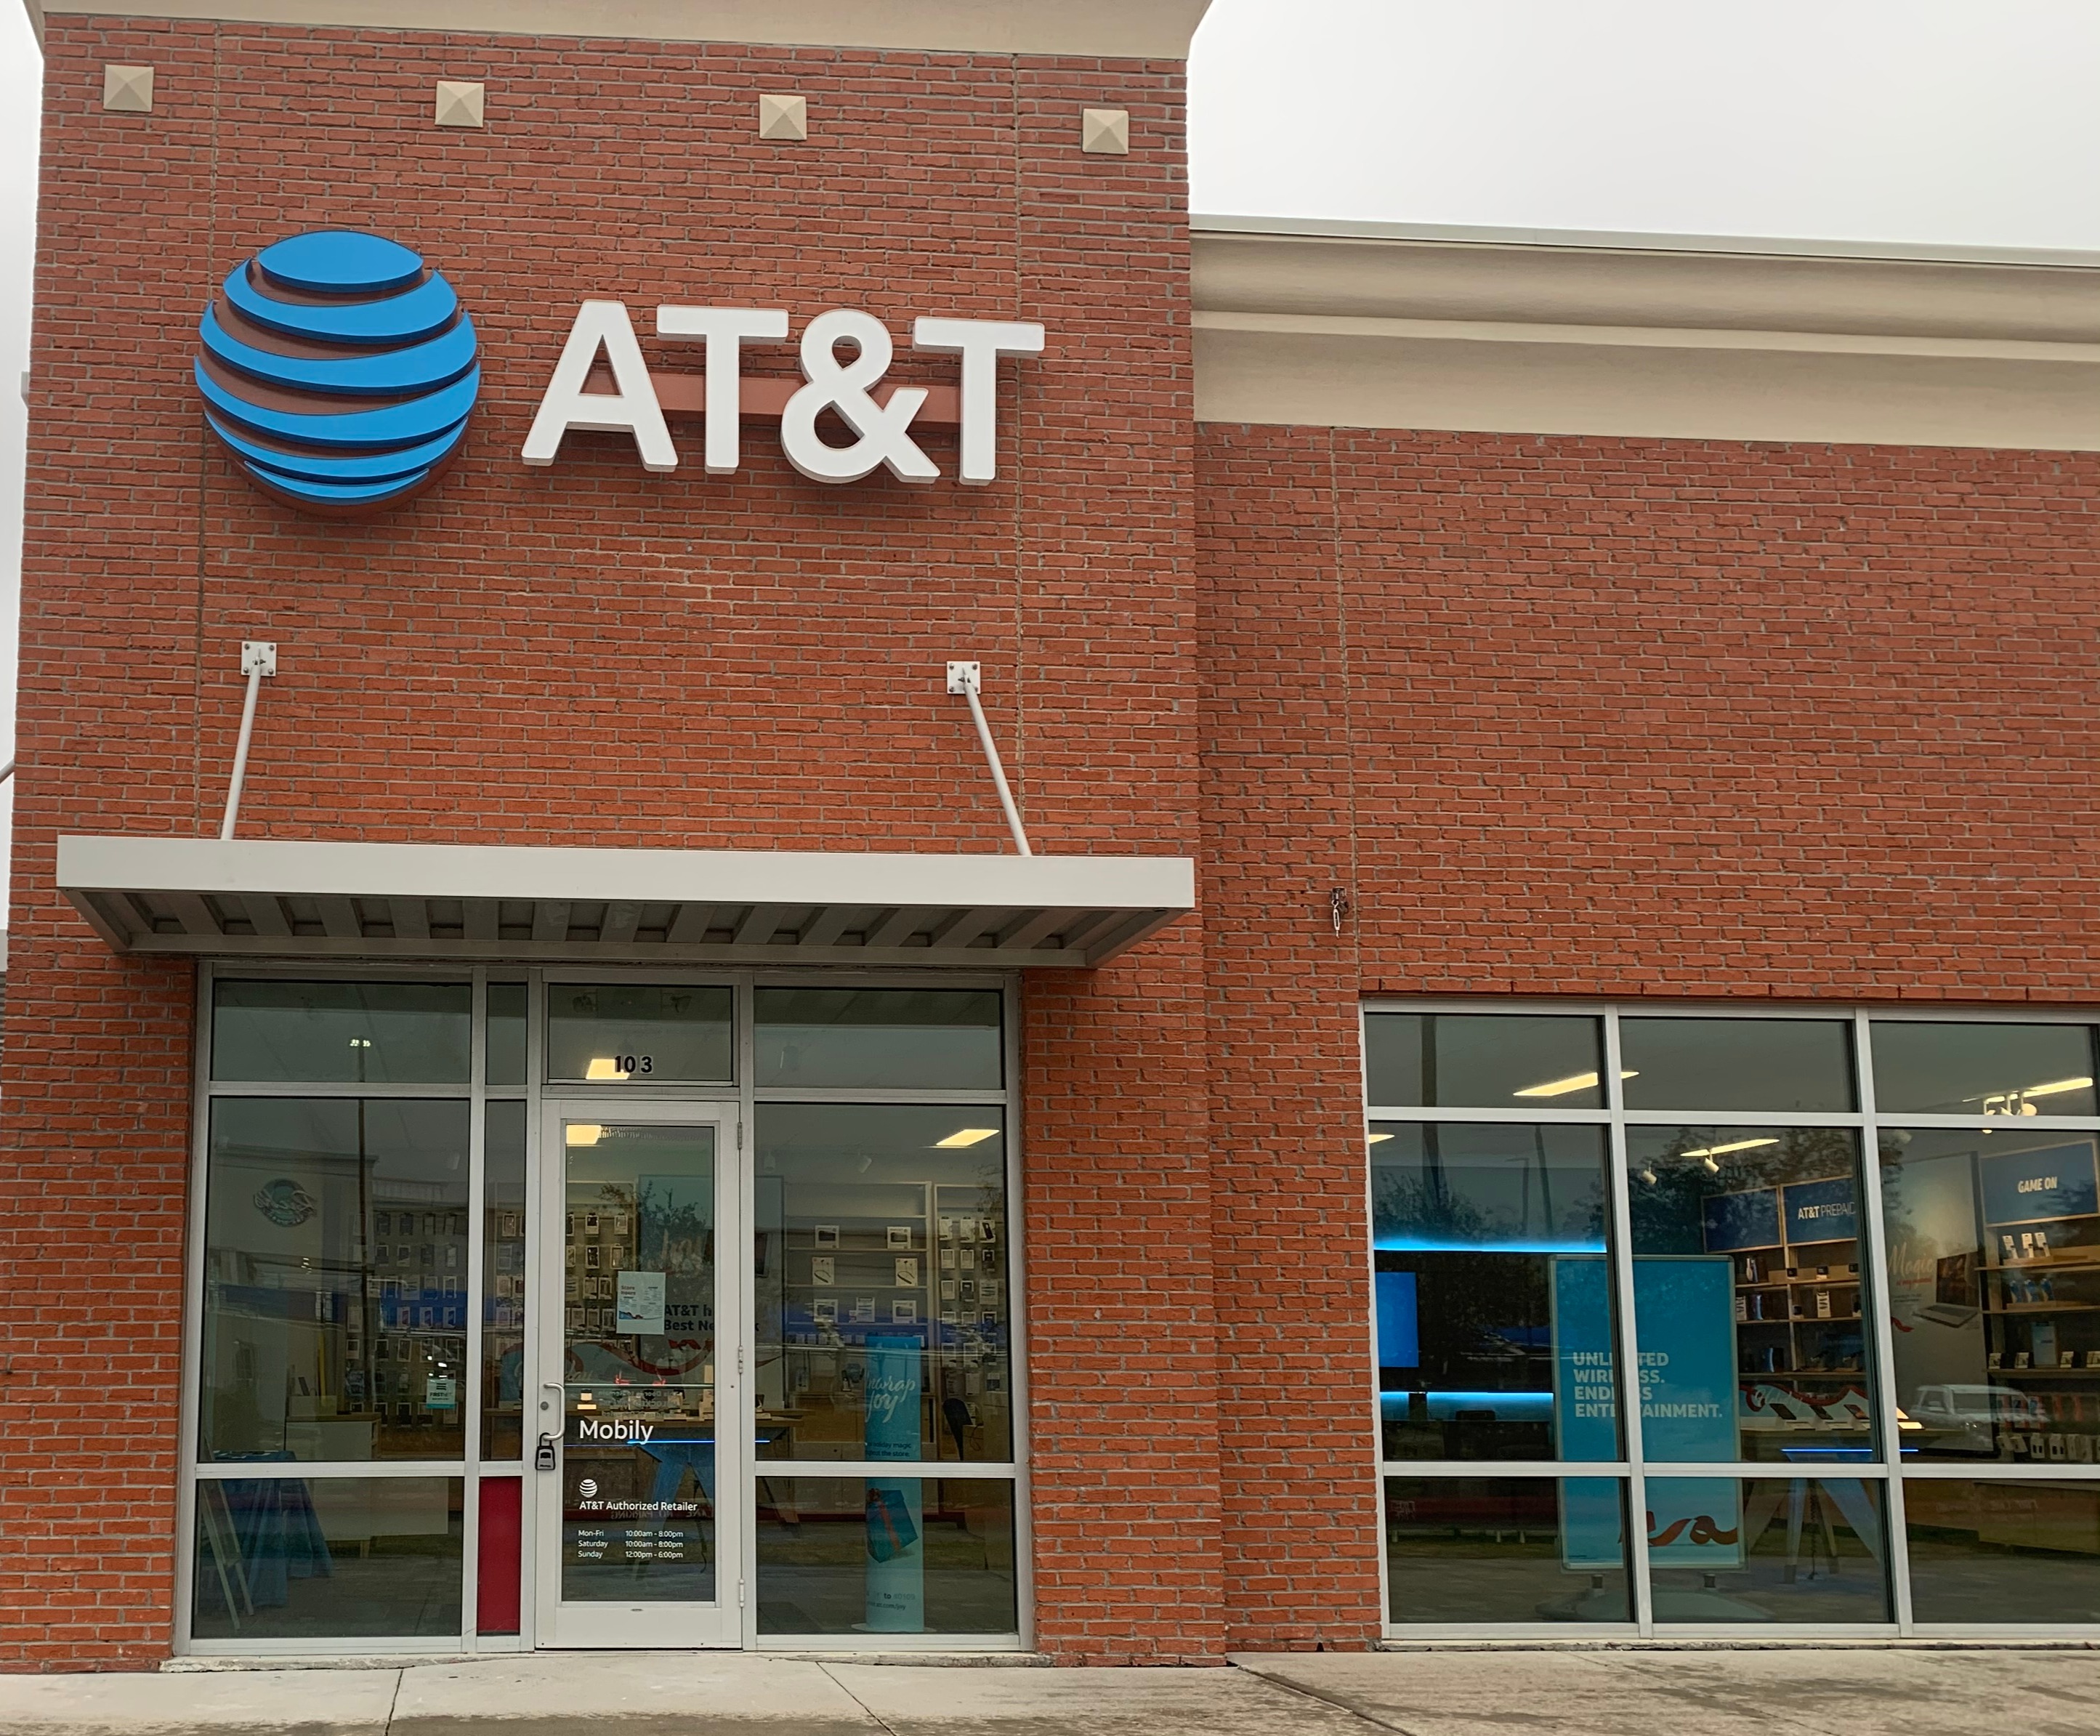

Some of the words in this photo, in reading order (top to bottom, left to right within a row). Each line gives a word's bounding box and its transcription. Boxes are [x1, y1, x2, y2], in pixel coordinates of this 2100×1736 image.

[520, 298, 1045, 485] AT&T
[615, 1055, 653, 1073] 103
[2017, 1178, 2043, 1193] GAME
[2045, 1176, 2058, 1190] ON
[1798, 1206, 1820, 1220] AT&T
[664, 1319, 695, 1331] Best
[1572, 1352, 1669, 1366] UNLITED
[1573, 1369, 1665, 1383] WIRSS.
[1575, 1386, 1652, 1401] ENDS
[1575, 1404, 1723, 1418] ENTEAINMENT.
[580, 1419, 654, 1445] Mobily
[579, 1501, 604, 1510] AT&T
[606, 1501, 658, 1511] Authorized
[661, 1502, 698, 1511] Retailer
[578, 1540, 608, 1549] Saturday
